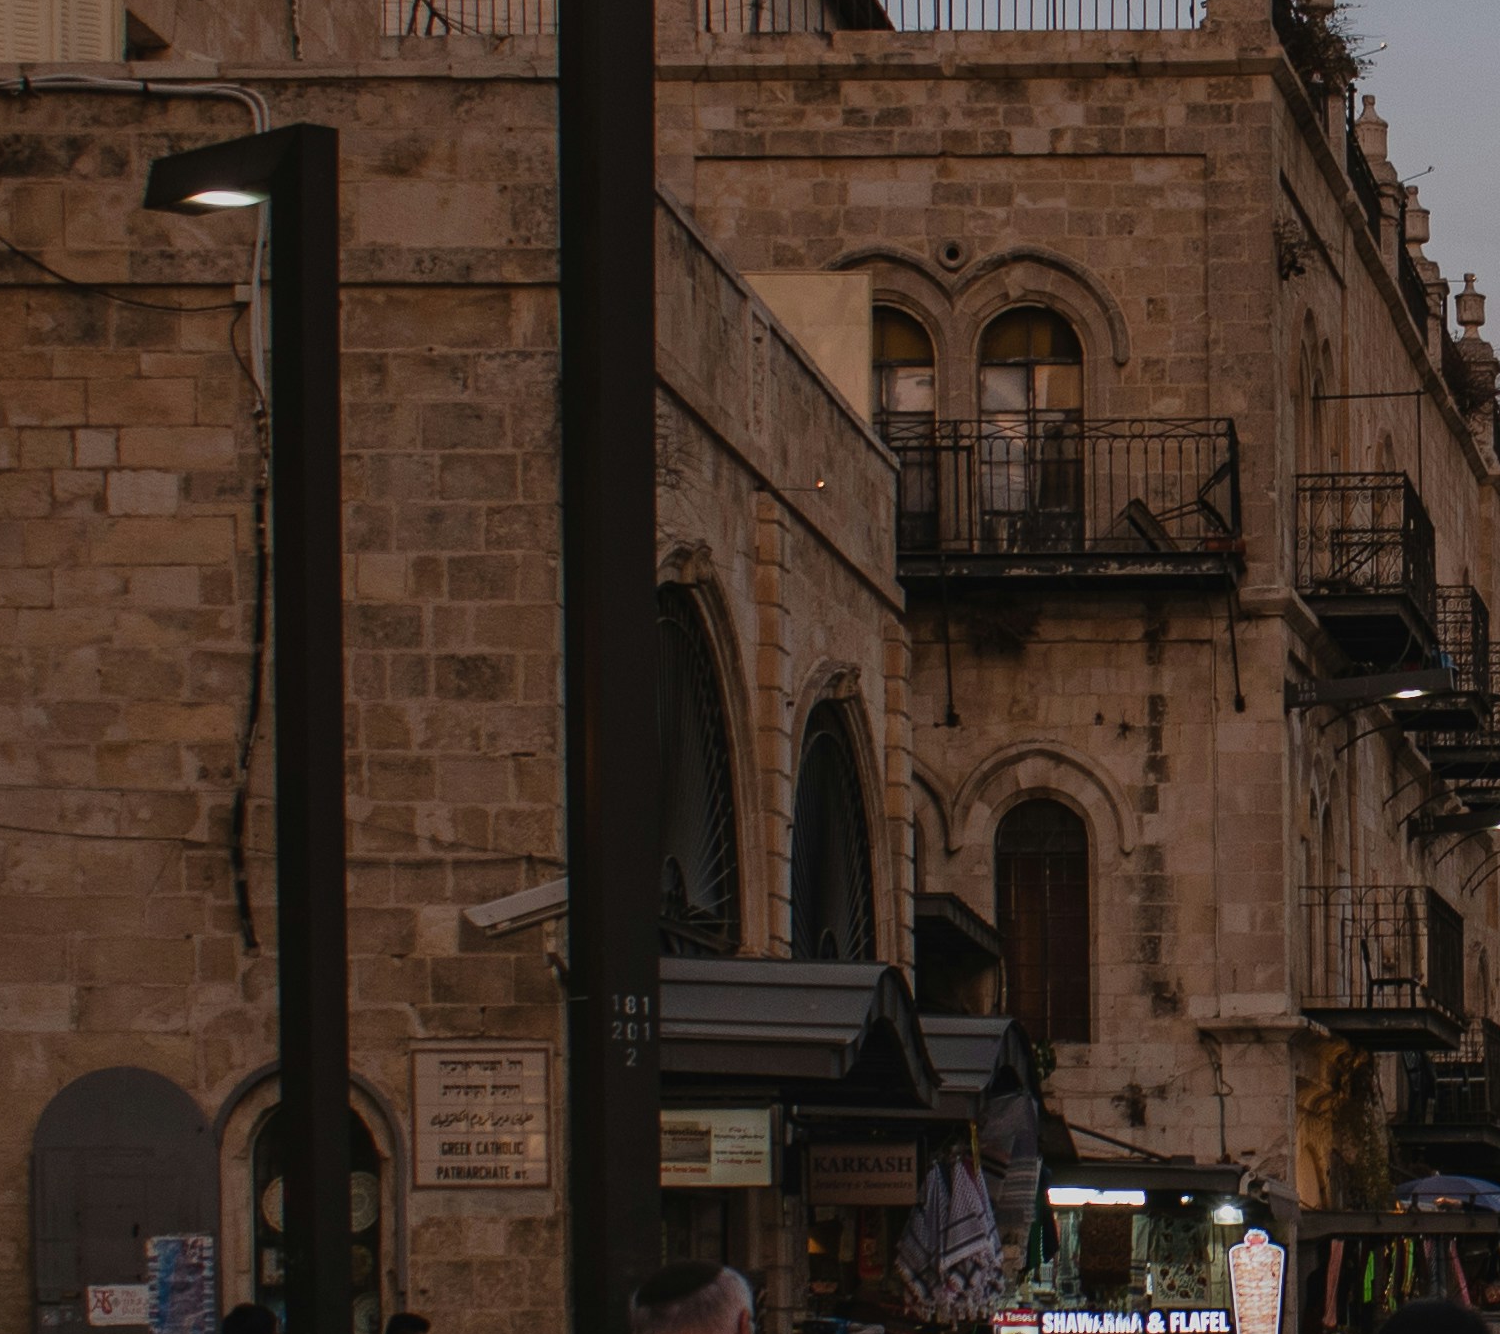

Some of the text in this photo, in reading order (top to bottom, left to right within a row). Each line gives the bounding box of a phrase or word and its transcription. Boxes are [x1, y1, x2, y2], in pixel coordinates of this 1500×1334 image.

[611, 994, 651, 1016] 181
[611, 1021, 651, 1041] 201
[626, 1047, 638, 1067] 2
[441, 1141, 525, 1156] GREEK CATHOLIC
[436, 1166, 510, 1180] PATRIARCHATE
[813, 1156, 913, 1173] KARKASH
[1041, 1310, 1230, 1334] SHAWARMA & FLAFEL
